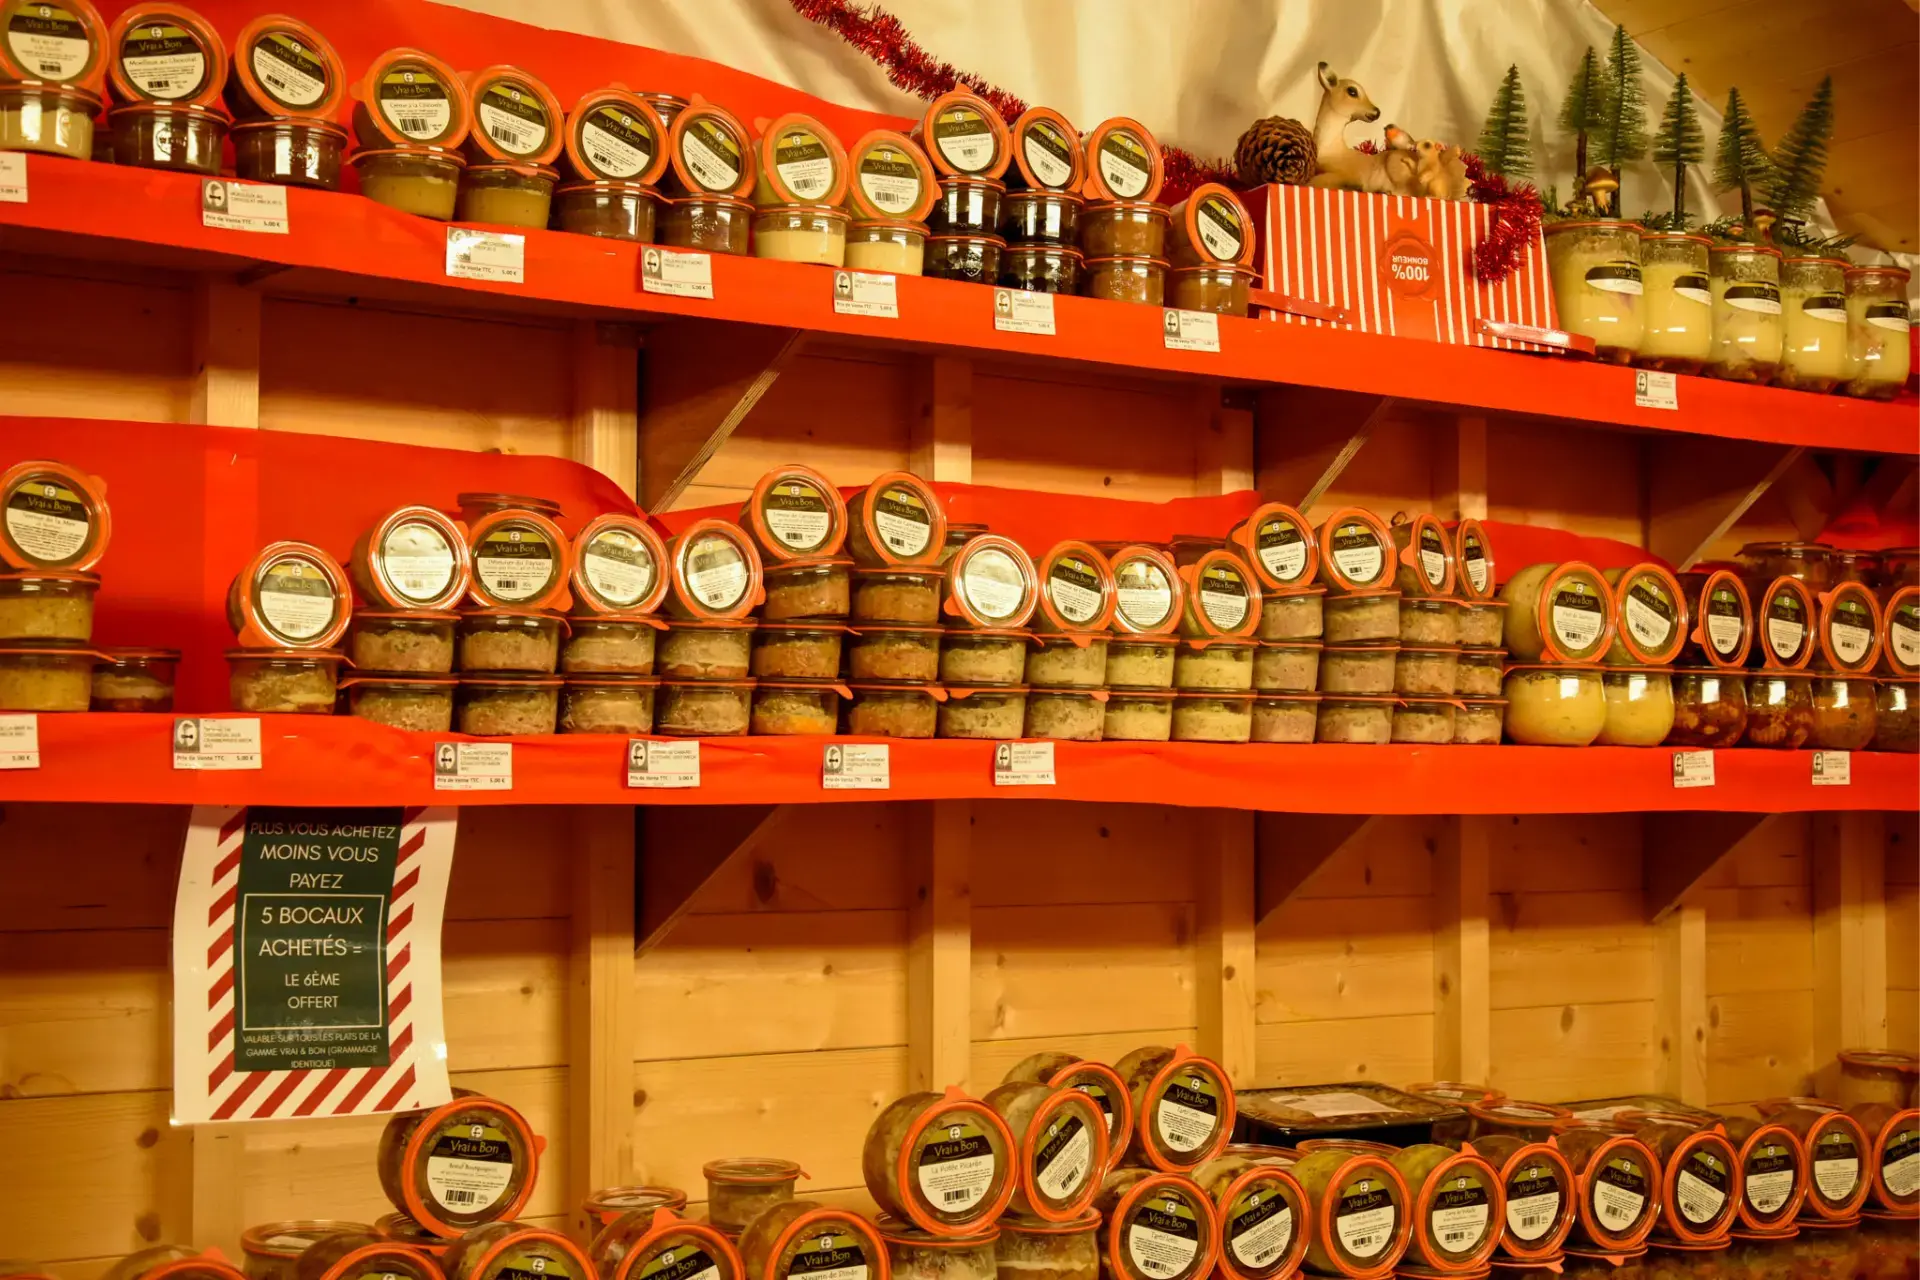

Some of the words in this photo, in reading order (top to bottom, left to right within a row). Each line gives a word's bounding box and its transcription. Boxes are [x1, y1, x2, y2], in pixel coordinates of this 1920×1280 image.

[139, 42, 156, 51] Vrai
[164, 40, 182, 48] Bon
[275, 46, 290, 59] Vrai
[296, 57, 313, 70] Bon
[498, 98, 513, 108] Vrai
[519, 105, 533, 115] Bon
[605, 120, 620, 134] Vrai
[625, 130, 640, 143] Bon
[703, 133, 714, 145] Vrai
[719, 145, 731, 158] Bon
[874, 163, 886, 171] Vrai
[892, 164, 904, 172] Bon
[1392, 255, 1428, 265] BONHEUR
[1392, 265, 1429, 281] 100%
[28, 498, 46, 508] Vrai
[54, 502, 72, 512] Bon
[889, 503, 901, 511] Vrai
[906, 507, 918, 516] Bon
[496, 545, 513, 553] Vrai
[520, 544, 536, 553] Bon
[251, 822, 283, 835] PLUS
[288, 823, 328, 836] VOUS
[332, 825, 396, 839] ACHETEZ
[260, 844, 321, 861] MOINS
[327, 846, 379, 862] VOUS
[290, 873, 343, 889] PAYEZ
[261, 907, 272, 924] 5
[279, 906, 364, 924] BOCAUX
[259, 934, 347, 956] ACHETÉS
[285, 974, 299, 986] LE
[304, 971, 340, 986] 6ÈME
[287, 996, 339, 1009] OFFERT
[244, 1035, 276, 1044] VALABLE
[278, 1034, 294, 1043] SUR
[319, 1033, 334, 1042] LES
[335, 1033, 357, 1042] PLATS
[359, 1032, 369, 1040] DE
[371, 1032, 381, 1040] LA
[246, 1048, 278, 1057] GAMME
[280, 1047, 298, 1056] VRAI
[309, 1046, 325, 1055] BON
[328, 1045, 377, 1056] (GRAMMAGE
[291, 1060, 335, 1068] IDENTIQUE)
[1176, 1089, 1189, 1099] Vrai
[1195, 1093, 1208, 1105] Bon
[451, 1140, 470, 1152] Vrai
[479, 1142, 499, 1154] Bon
[935, 1143, 953, 1157] Vrai
[961, 1140, 978, 1152] Bon
[1043, 1146, 1055, 1159] Vrai
[1059, 1125, 1073, 1141] Bon
[1349, 1197, 1362, 1208] Vrai
[1369, 1194, 1381, 1203] Bon
[1445, 1194, 1457, 1204] Vrai
[1464, 1192, 1477, 1200] Bon
[1149, 1212, 1163, 1224] Vrai
[1171, 1218, 1187, 1229] Bon
[1241, 1214, 1255, 1226] Vrai
[1261, 1202, 1275, 1214] Bon
[677, 1259, 697, 1273] Bon
[804, 1256, 824, 1267] Vrai
[832, 1252, 850, 1261] Bon
